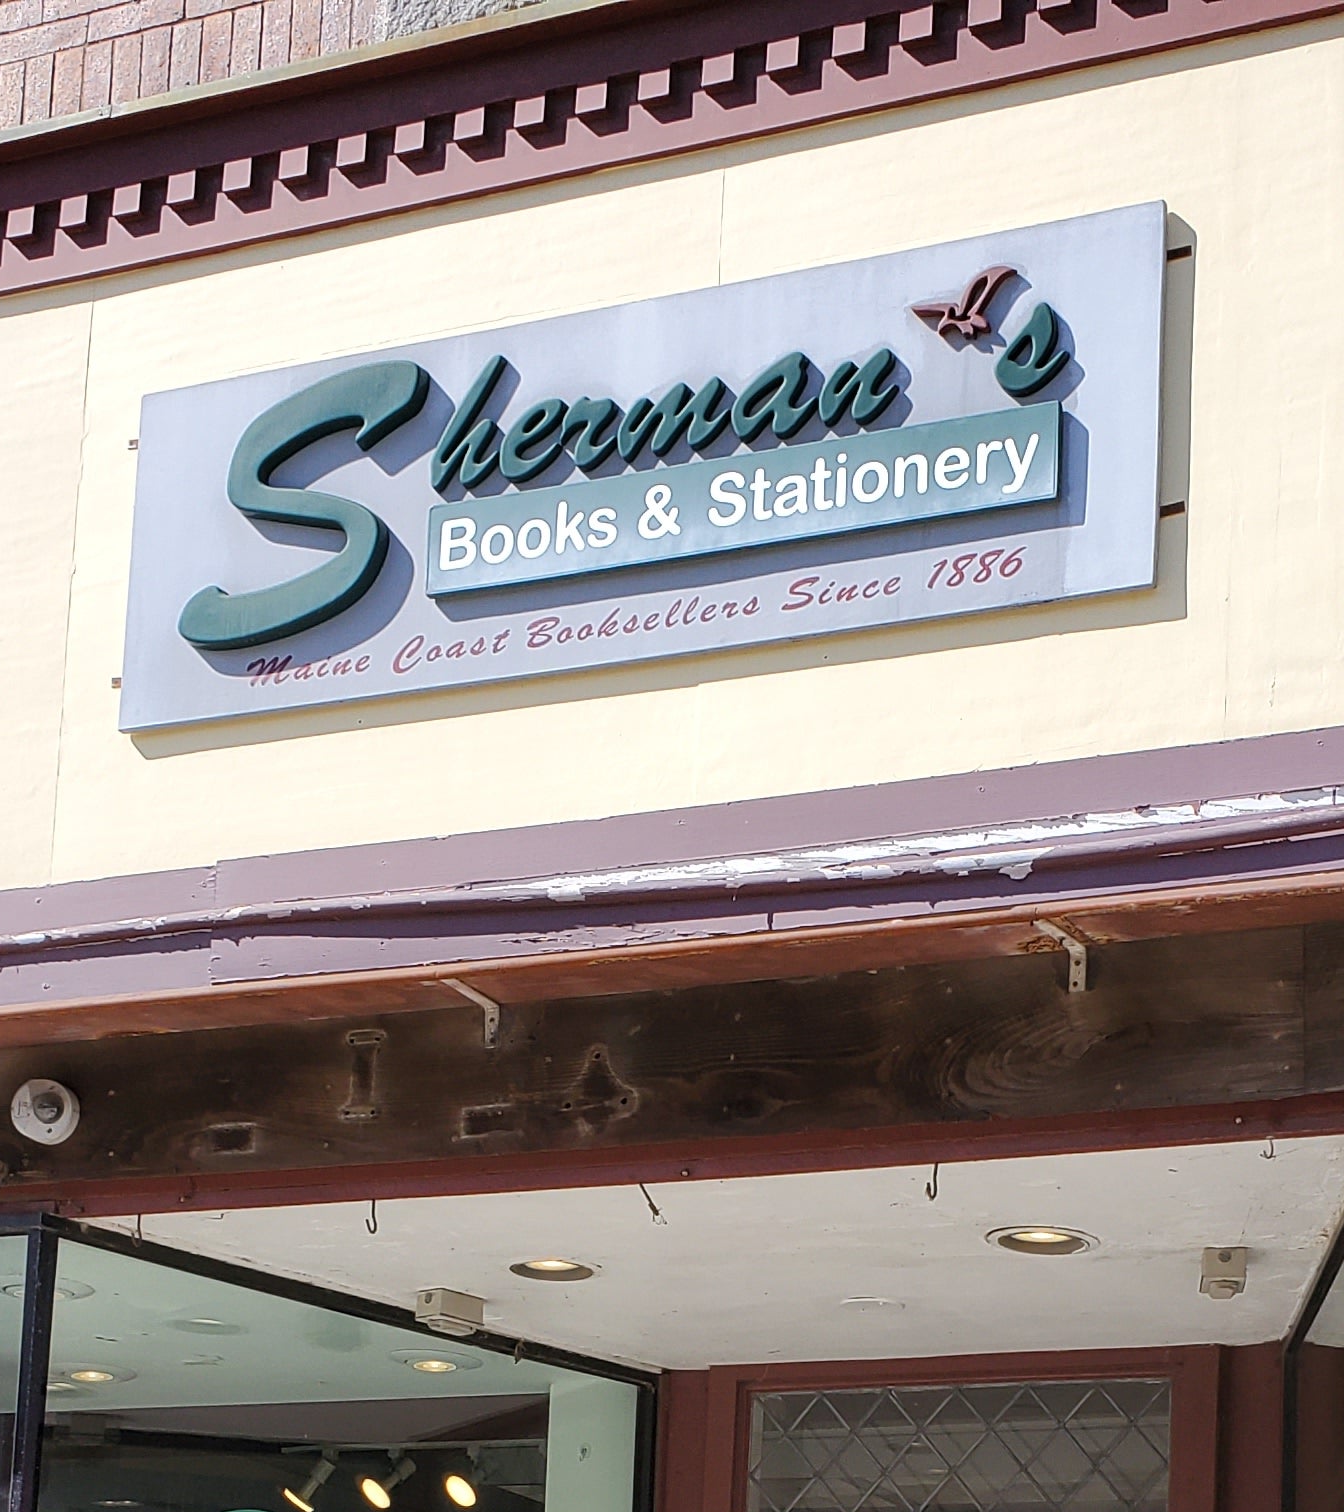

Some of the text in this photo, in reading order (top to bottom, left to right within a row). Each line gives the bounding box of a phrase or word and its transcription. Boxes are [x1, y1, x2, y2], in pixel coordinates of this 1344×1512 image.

[178, 290, 1071, 652] Sherman's
[439, 431, 1040, 572] Books & Stationery
[247, 545, 1027, 687] Maine Coast Booksellers Since 1886
